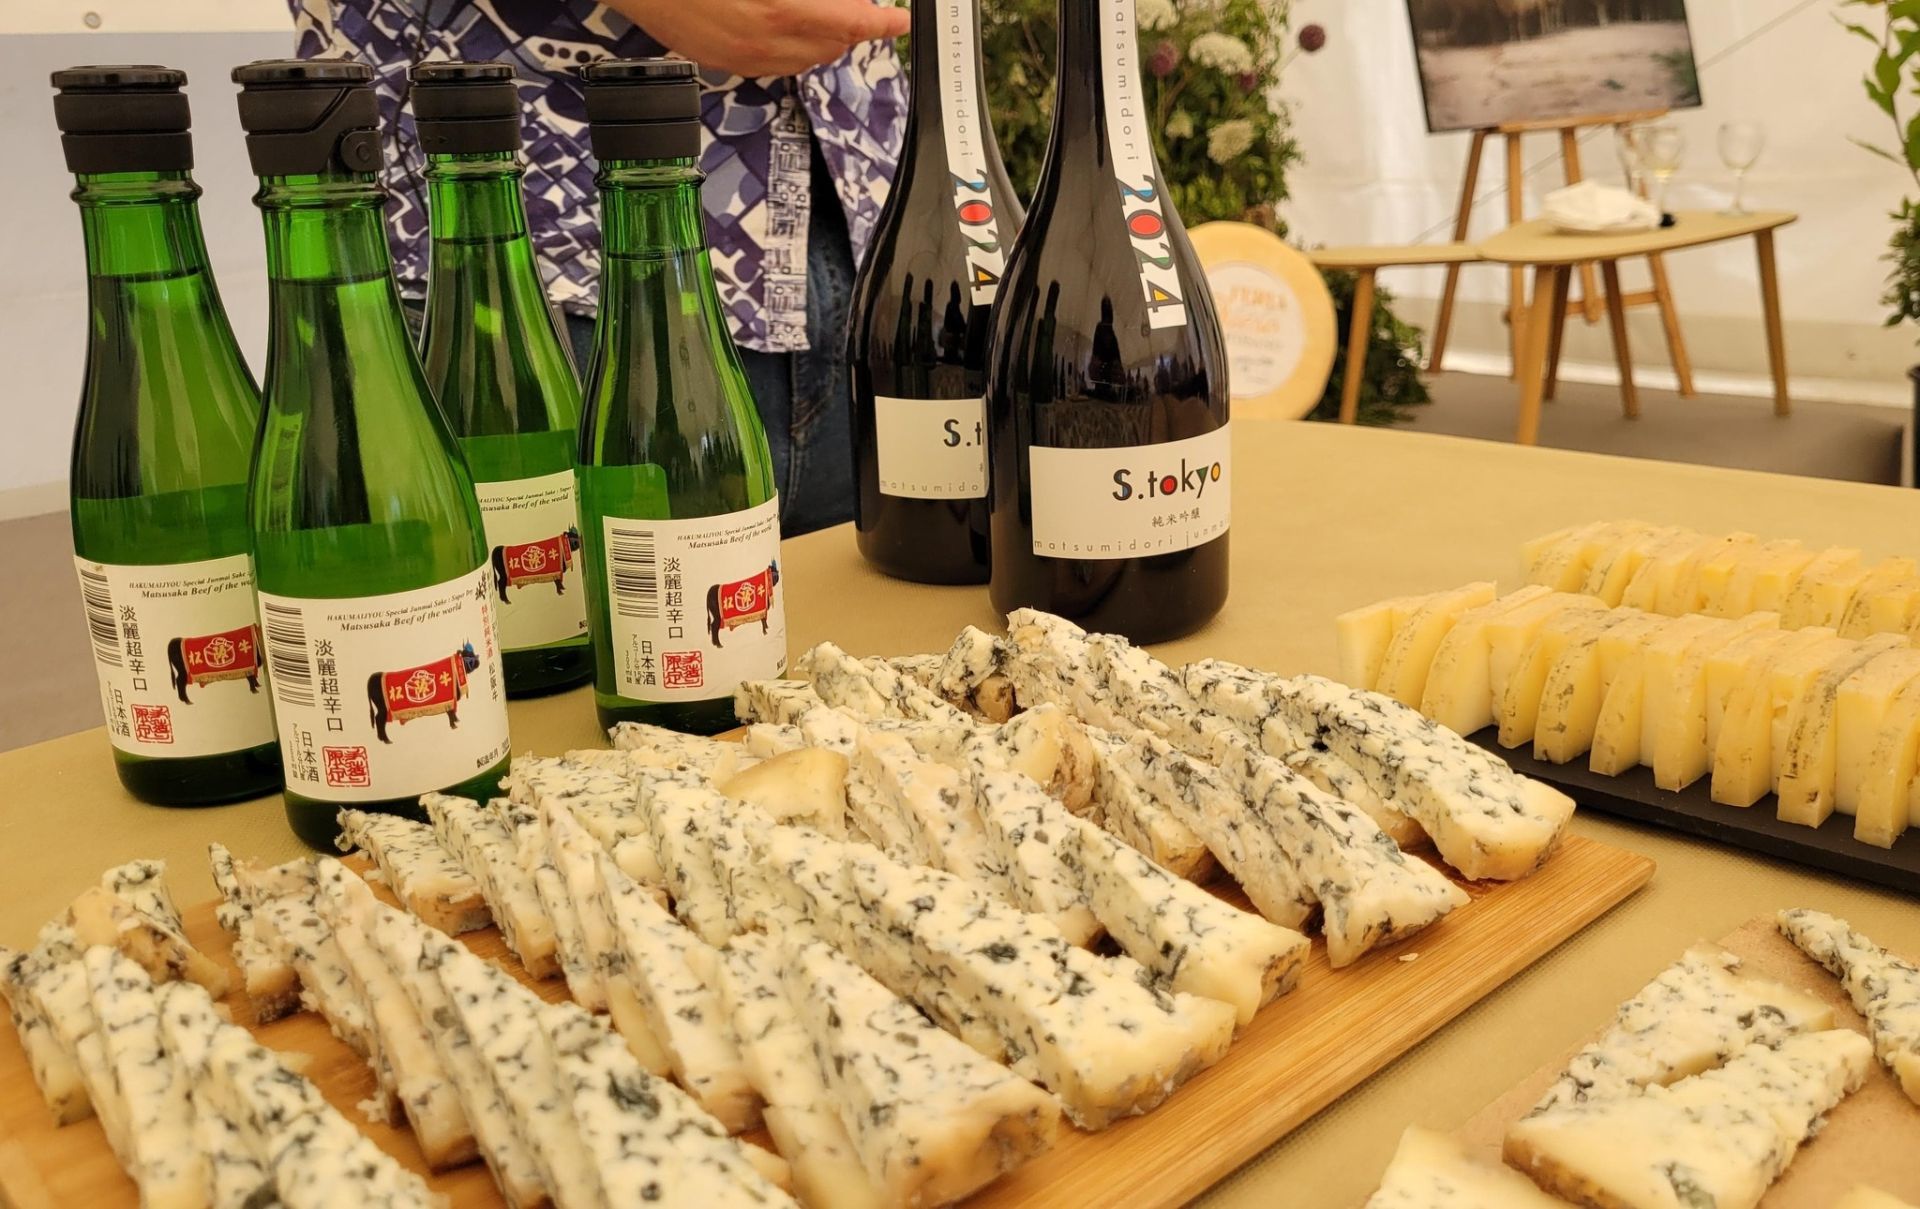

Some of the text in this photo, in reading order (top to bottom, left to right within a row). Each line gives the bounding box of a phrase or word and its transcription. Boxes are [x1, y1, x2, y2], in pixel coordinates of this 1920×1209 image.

[949, 5, 973, 158] matsumidori
[1116, 0, 1139, 161] atsumidori
[950, 169, 1001, 292] 2024
[1116, 174, 1185, 313] 2024
[512, 501, 530, 510] Beef
[530, 499, 538, 507] of
[539, 497, 550, 505] the
[551, 493, 569, 502] world
[1112, 458, 1222, 501] S.tokyo
[688, 538, 728, 549] Matsusaka
[730, 534, 745, 544] Beef
[745, 532, 752, 541] of
[752, 529, 760, 538] the
[1034, 533, 1173, 553] matsumidori
[142, 589, 188, 598] Matsusaka
[191, 585, 212, 596] Beef
[213, 585, 224, 594] of
[225, 582, 238, 590] the
[663, 557, 684, 640] 淡麗超辛口
[340, 601, 463, 631] Matsusaka Beef of the world
[119, 604, 148, 692] 淡麗超辛口
[641, 640, 656, 686] 日本酒
[313, 638, 343, 733] 淡麗超辛口
[114, 689, 130, 738] 日本酒
[301, 731, 320, 783] 日本酒
